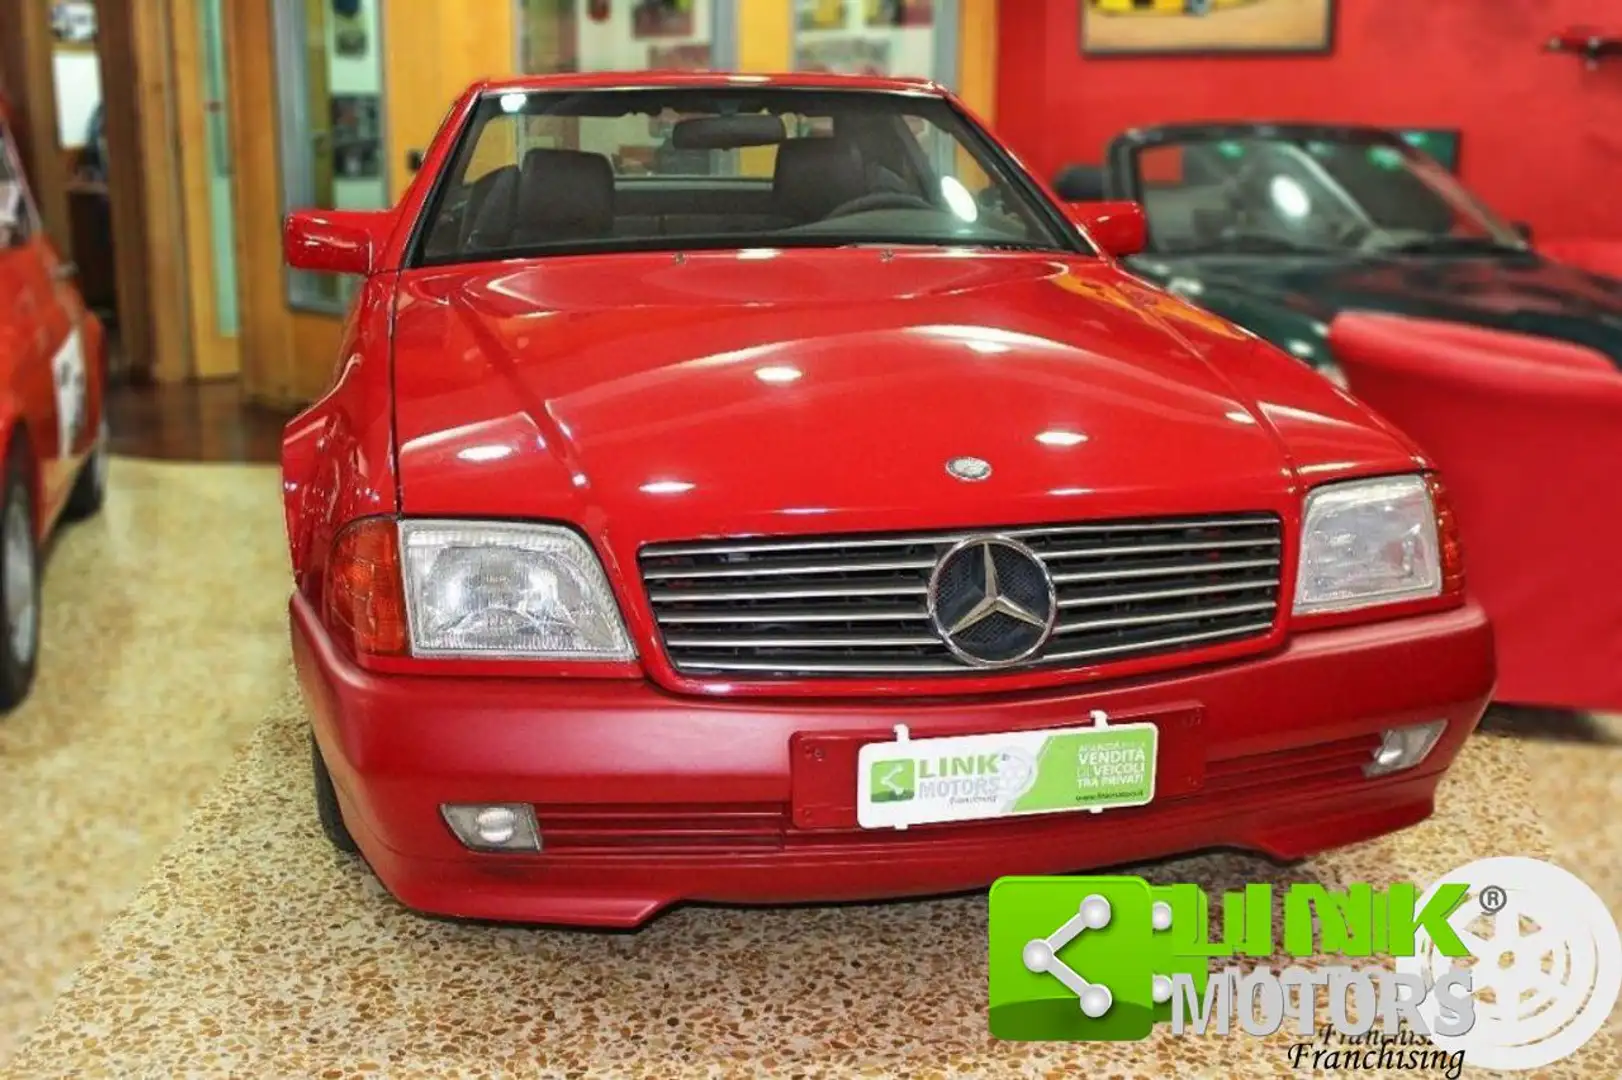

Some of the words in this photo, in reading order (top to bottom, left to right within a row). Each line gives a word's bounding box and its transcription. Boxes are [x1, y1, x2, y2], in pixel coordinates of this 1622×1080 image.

[1079, 747, 1146, 766] VENDITA
[918, 754, 999, 779] LINK
[1093, 762, 1145, 777] VEICOLI
[918, 777, 1001, 800] MOTORS
[1077, 777, 1099, 789] TRA
[1101, 774, 1145, 787] PRIVATI
